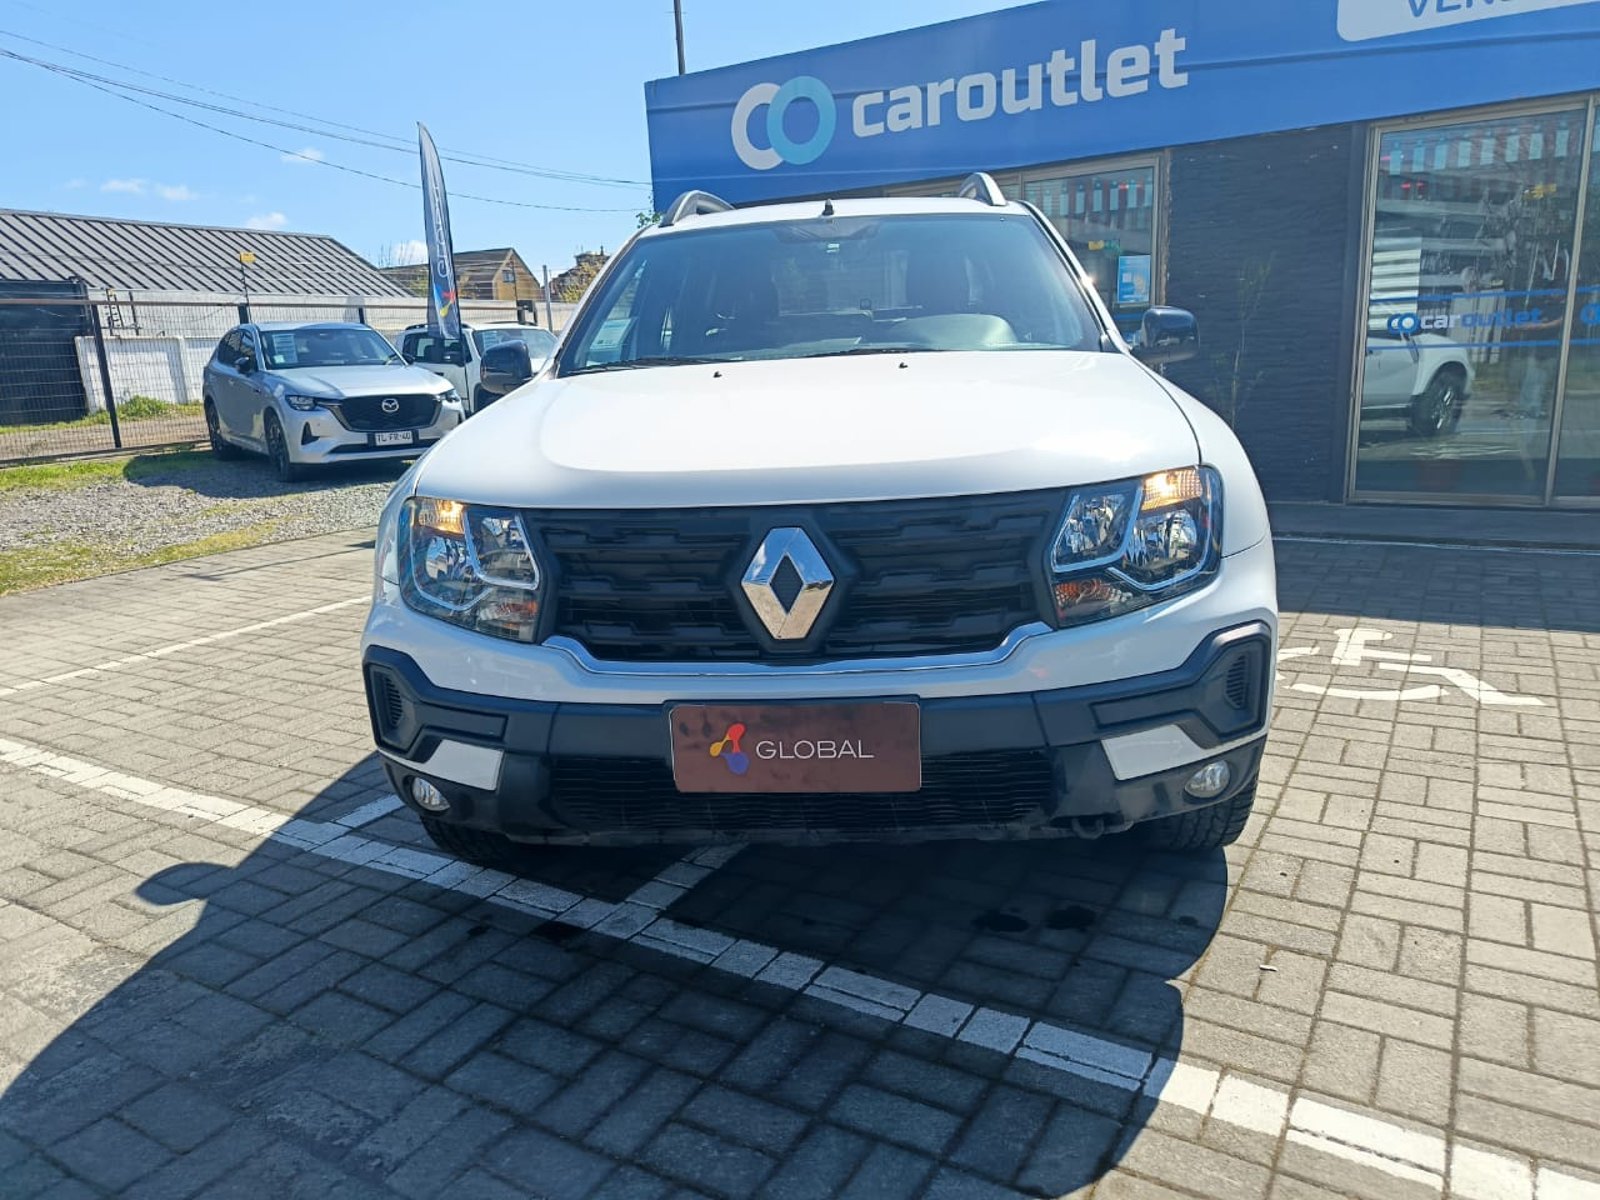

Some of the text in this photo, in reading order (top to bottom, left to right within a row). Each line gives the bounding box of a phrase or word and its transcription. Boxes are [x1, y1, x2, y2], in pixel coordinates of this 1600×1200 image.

[852, 28, 1189, 138] caroutlet
[1420, 307, 1544, 330] caroutlet
[755, 740, 875, 760] GLOBAL
